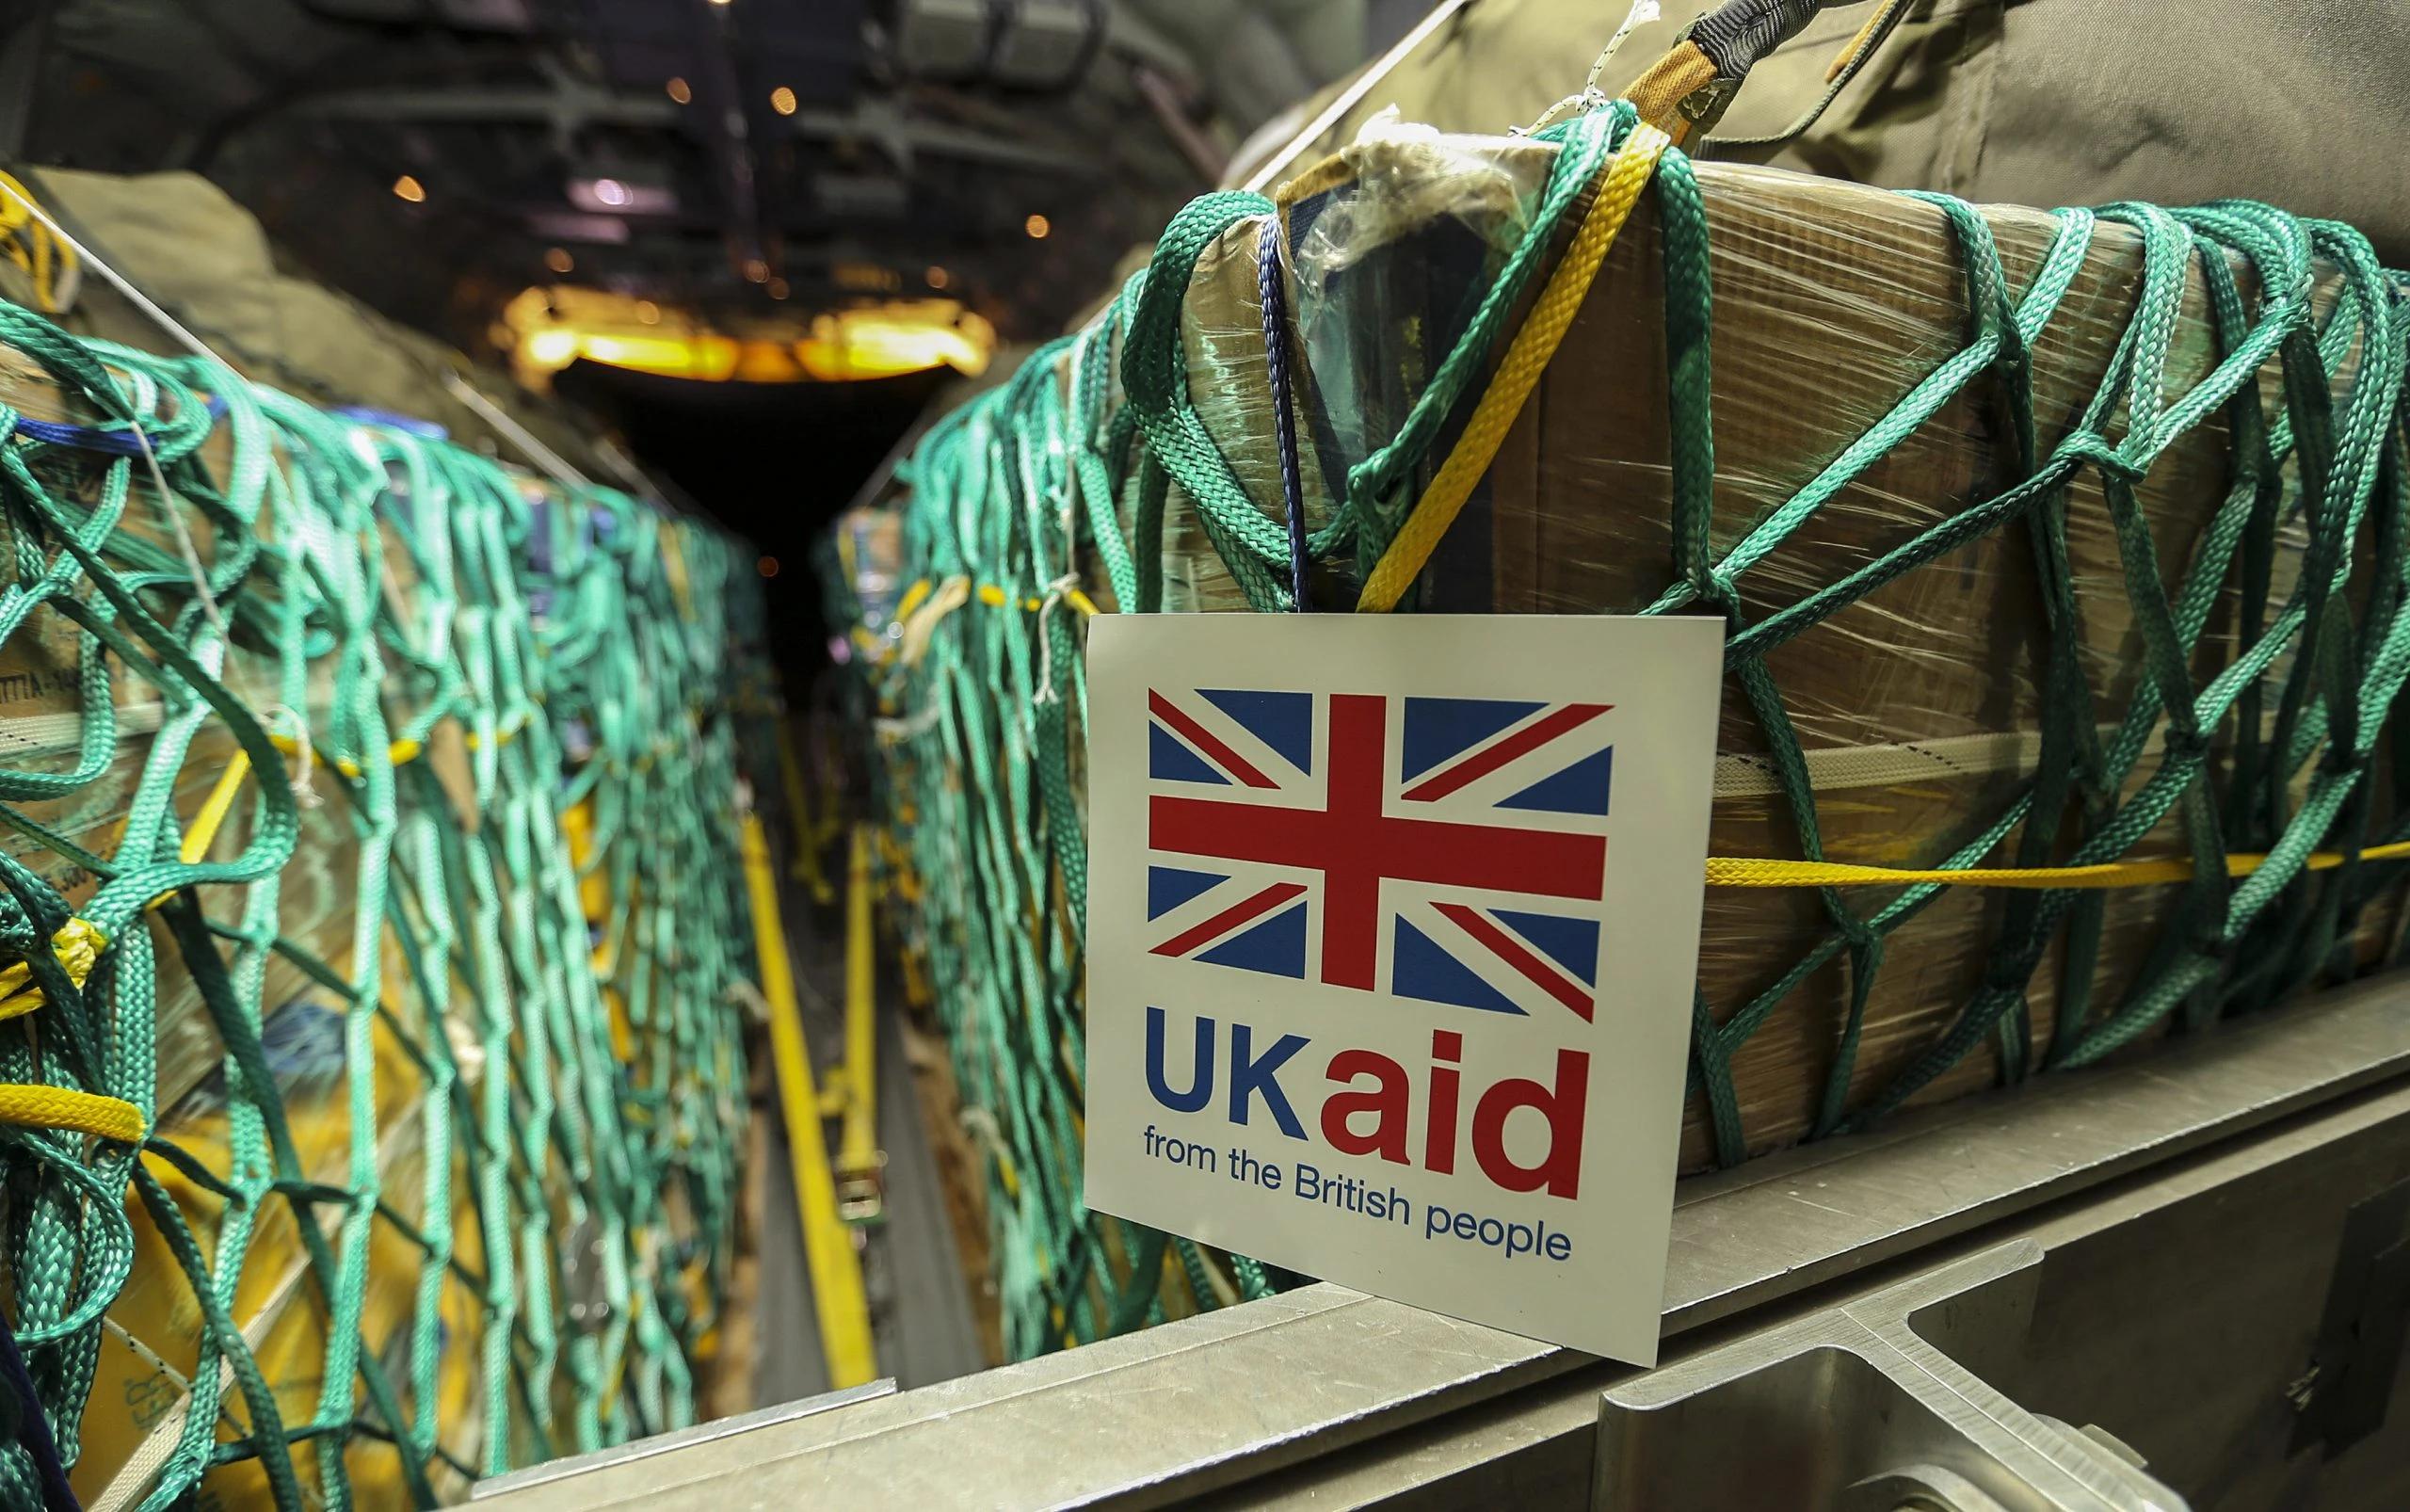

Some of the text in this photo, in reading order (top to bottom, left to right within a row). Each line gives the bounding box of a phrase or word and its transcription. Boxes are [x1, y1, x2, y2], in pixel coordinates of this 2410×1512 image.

[1145, 1125, 1572, 1260] from the British people
